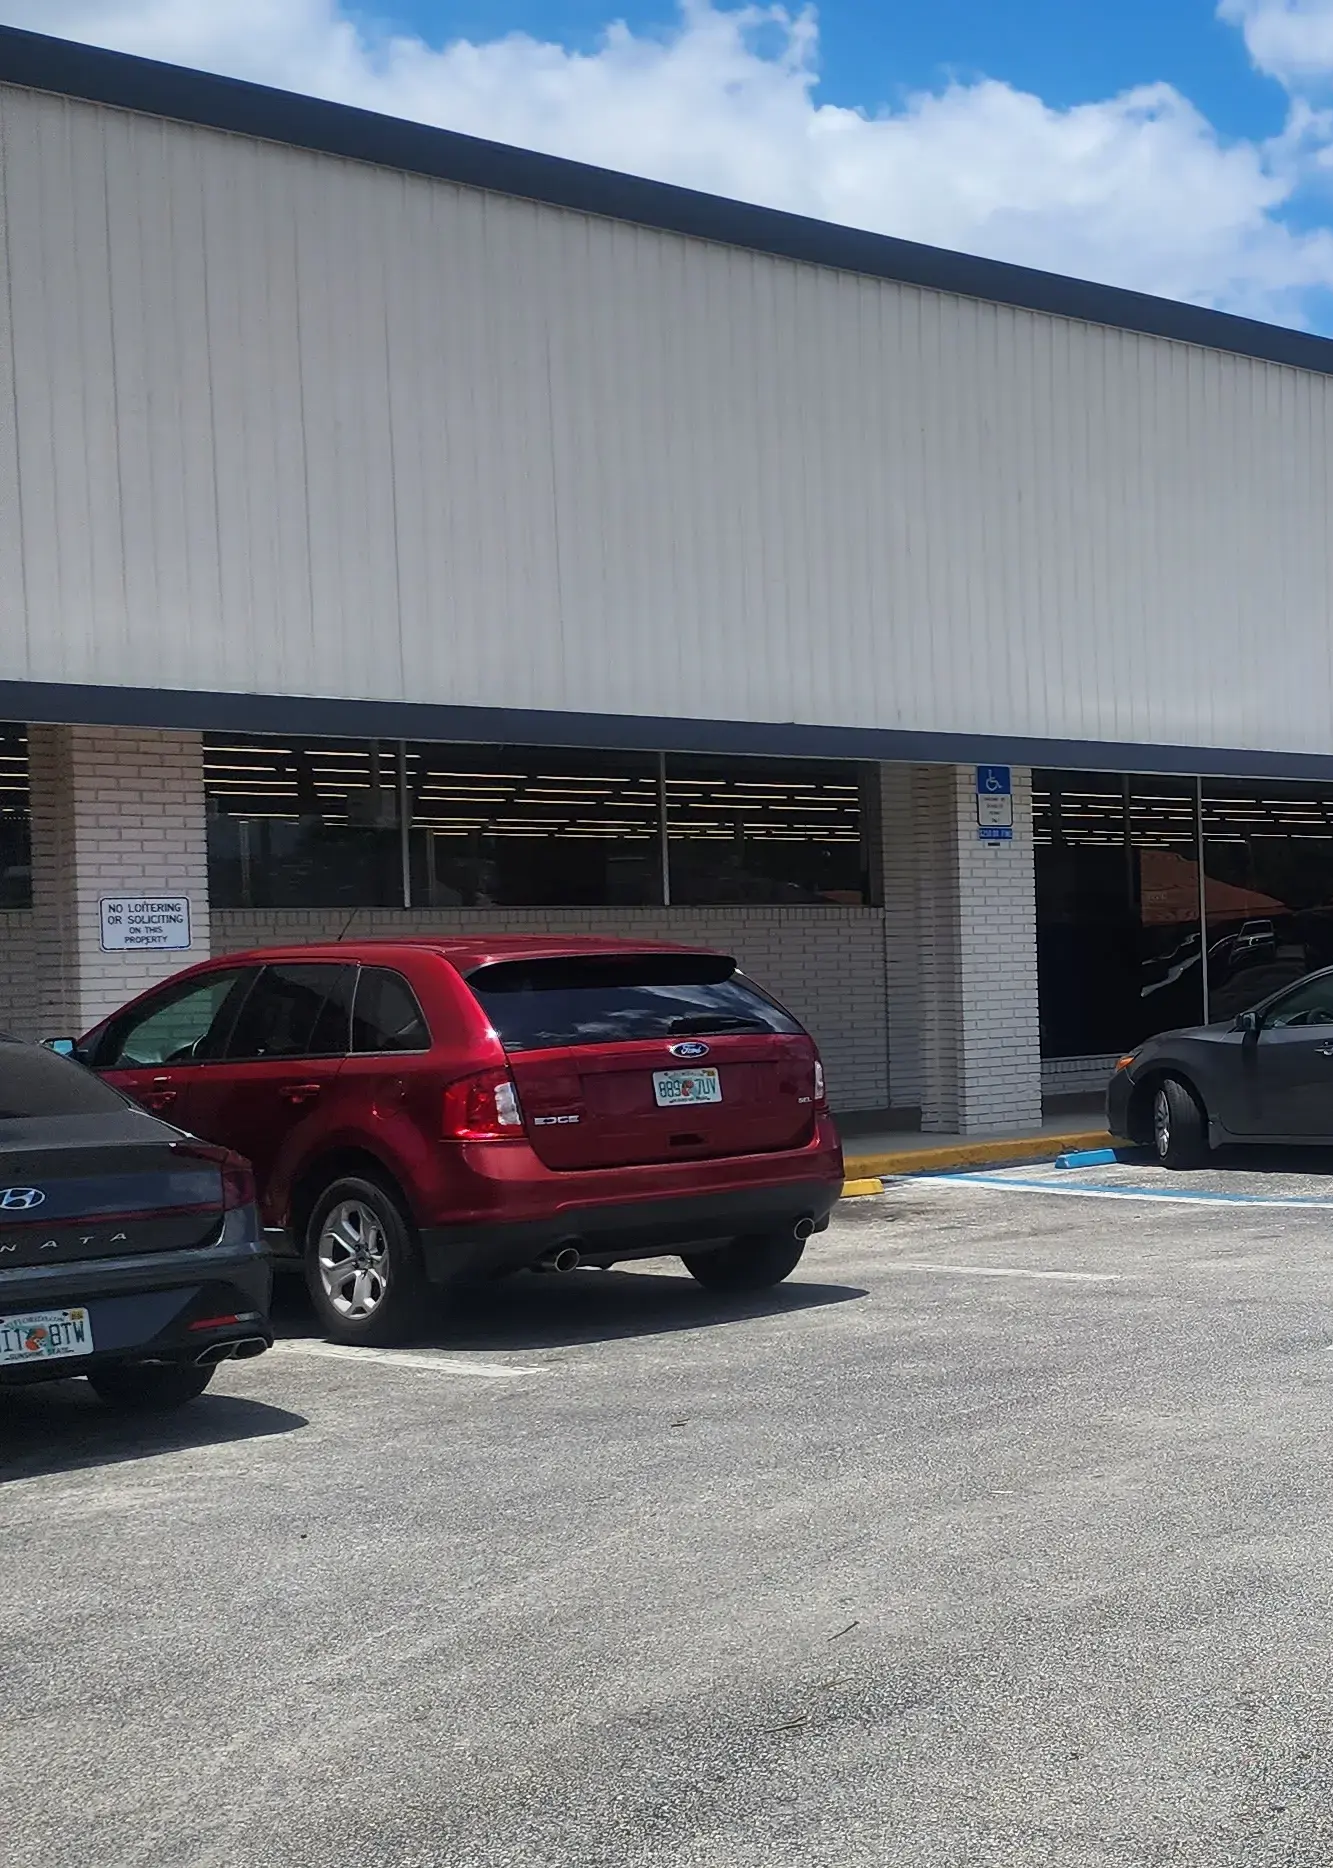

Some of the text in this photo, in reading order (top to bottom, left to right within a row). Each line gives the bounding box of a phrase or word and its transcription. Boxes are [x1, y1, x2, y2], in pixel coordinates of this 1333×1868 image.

[108, 903, 181, 913] NO LOITERING
[107, 914, 184, 925] OR SOLICITING
[129, 926, 163, 934] ON THIS
[124, 935, 168, 944] PROPERTY
[680, 1043, 703, 1055] Ford
[658, 1080, 682, 1098] 889
[534, 1114, 580, 1126] EDGE
[0, 1232, 127, 1252] NATA
